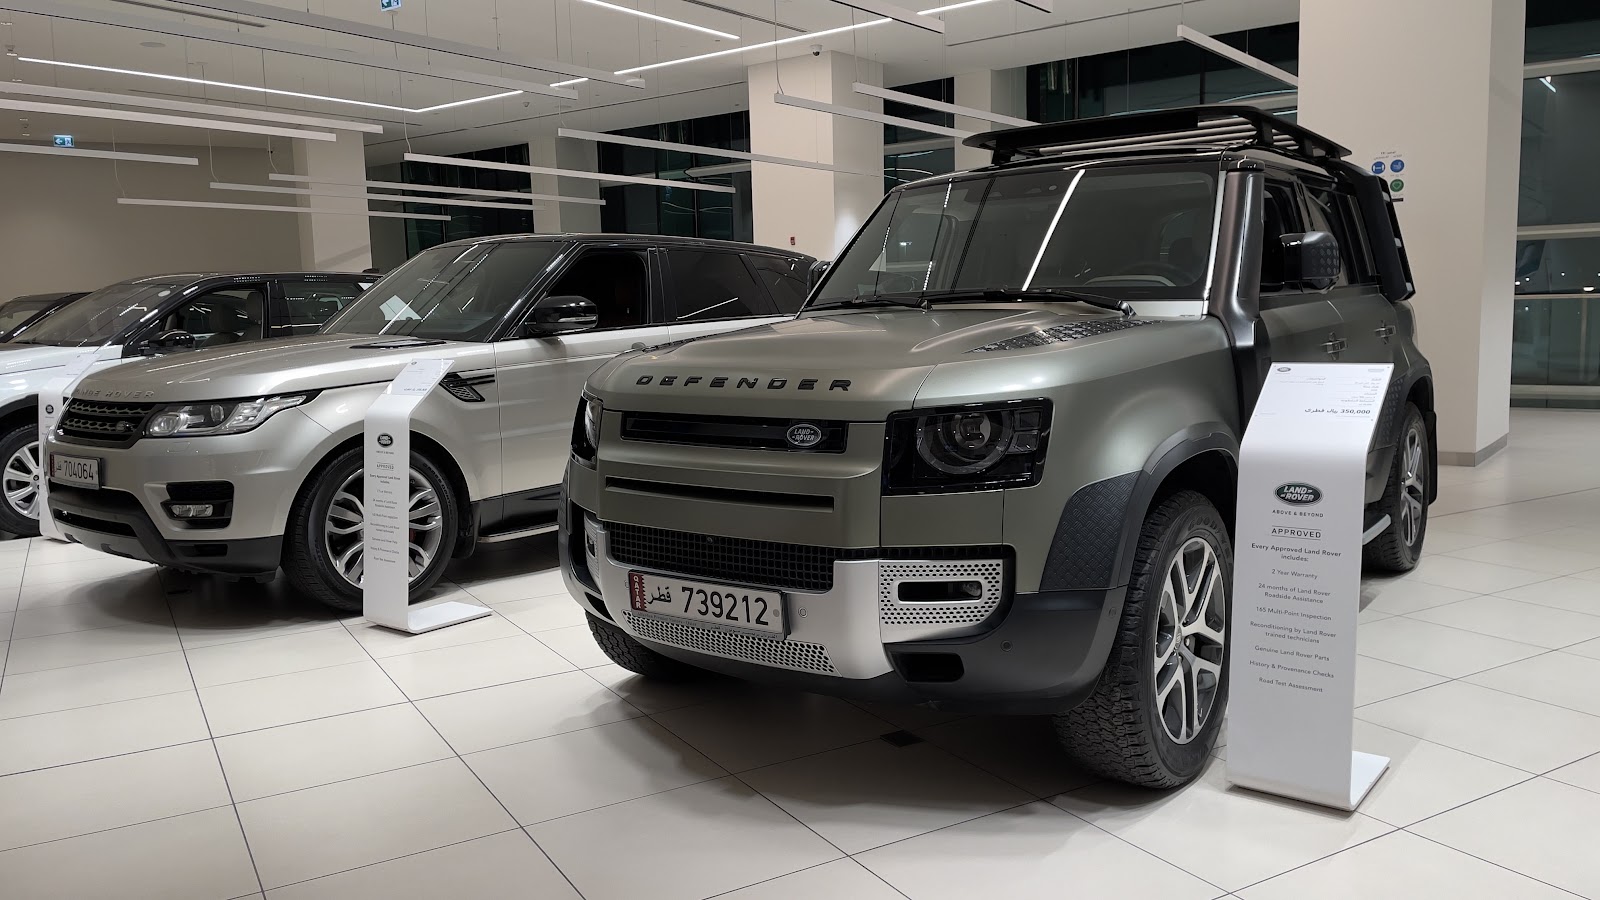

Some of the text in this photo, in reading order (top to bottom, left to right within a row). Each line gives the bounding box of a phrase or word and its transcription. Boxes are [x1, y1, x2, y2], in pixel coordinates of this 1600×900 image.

[635, 375, 852, 392] DEFENDER
[105, 390, 155, 399] ROVER
[64, 460, 94, 481] 704064
[1283, 485, 1308, 494] LAND
[1285, 493, 1314, 501] ROVER
[1271, 527, 1322, 539] APPROVED
[1251, 542, 1269, 551] Every
[1270, 545, 1303, 554] Approved
[1321, 549, 1342, 557] Rover
[1281, 553, 1309, 562] includes:
[1290, 570, 1318, 580] Warranty
[633, 575, 641, 609] QATAR
[646, 585, 672, 605] قطر
[1264, 591, 1324, 604] Roadside Assistance
[1266, 584, 1288, 592] months
[1297, 587, 1312, 595] Land
[1313, 589, 1331, 597] Rover
[681, 586, 769, 626] 739212
[1267, 607, 1300, 617] Multi-Point
[1300, 612, 1332, 621] Inspection
[1250, 620, 1293, 633] Reconditioning
[1319, 630, 1337, 638] Rover
[1265, 631, 1320, 644] trained technicians
[1254, 645, 1279, 654] Genuine
[1295, 651, 1313, 659] Rover
[1314, 653, 1330, 662] Parts
[1249, 660, 1270, 669] History
[1277, 664, 1311, 675] Provenance
[1312, 669, 1334, 679] Checks
[1258, 677, 1323, 693] Road Test Assessment
